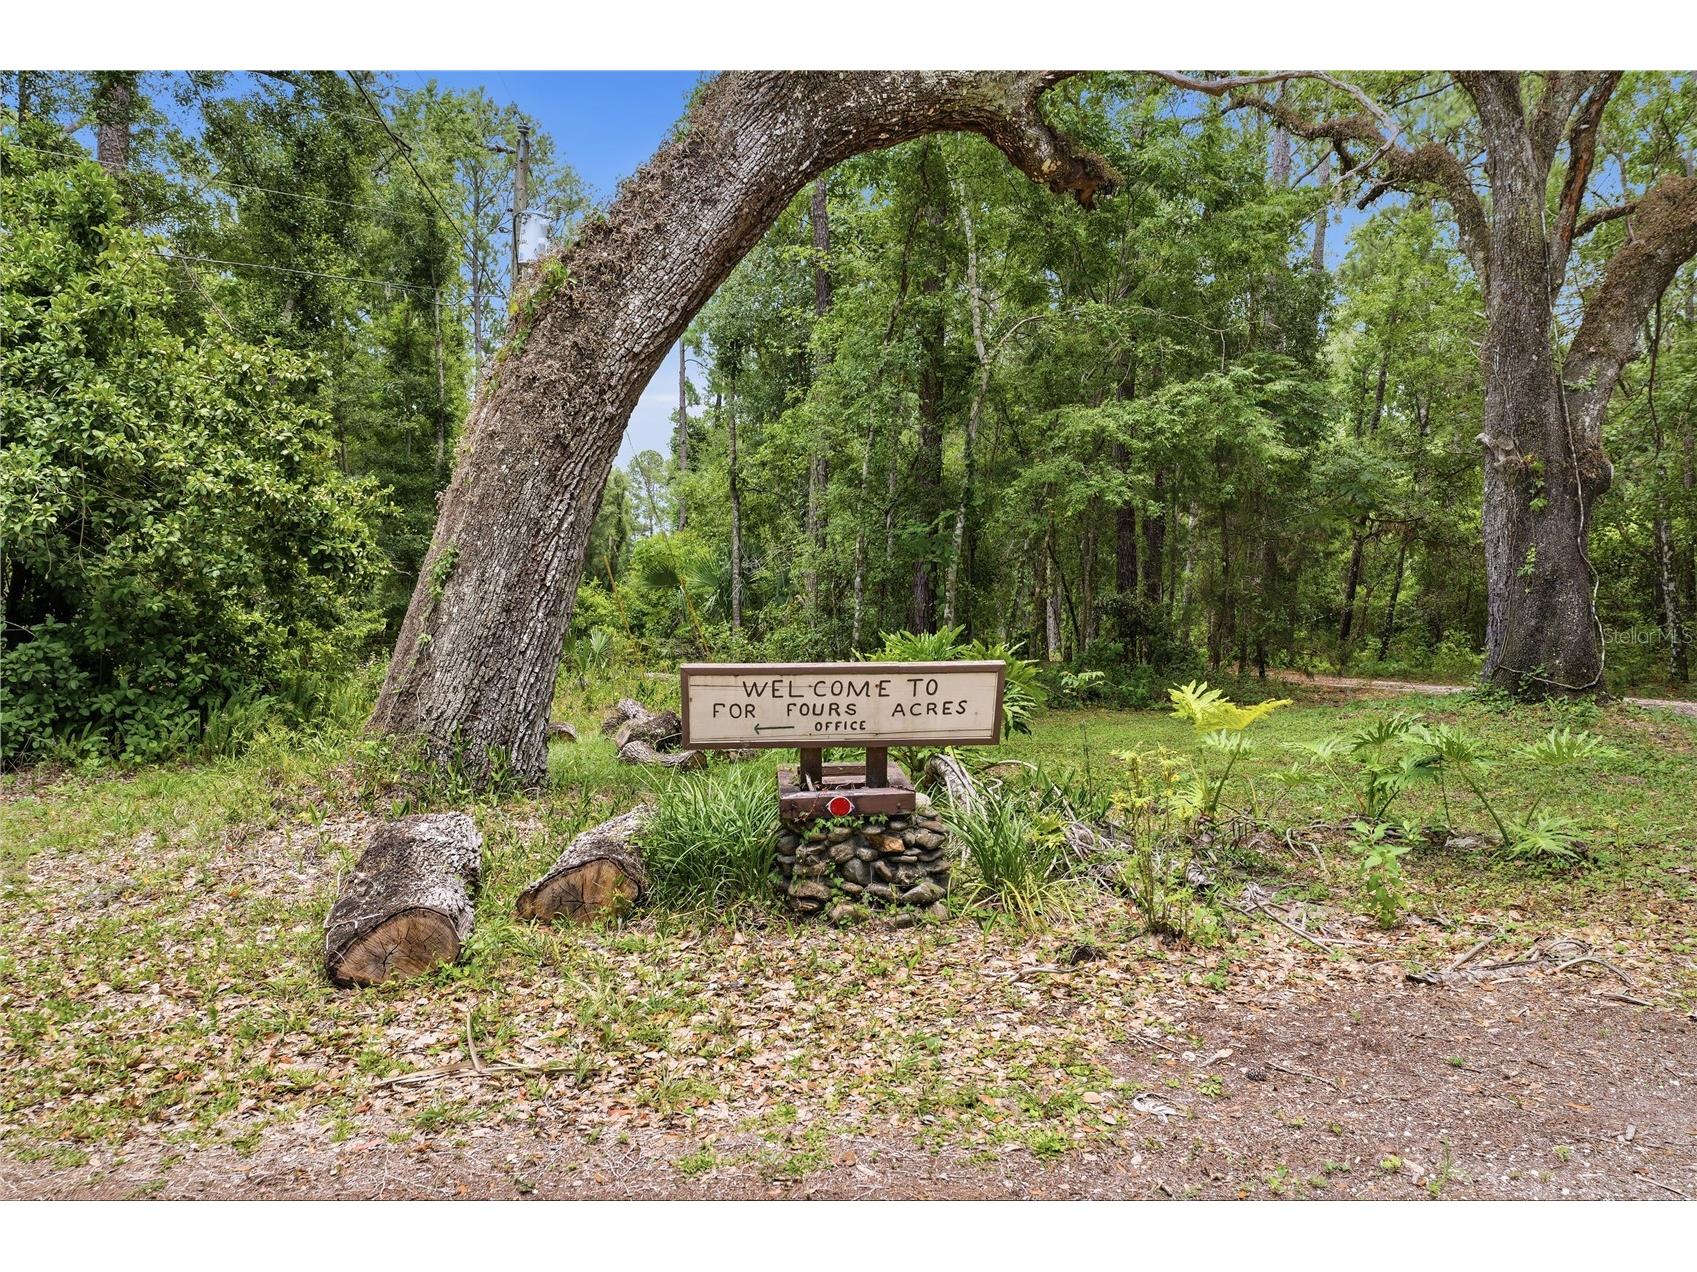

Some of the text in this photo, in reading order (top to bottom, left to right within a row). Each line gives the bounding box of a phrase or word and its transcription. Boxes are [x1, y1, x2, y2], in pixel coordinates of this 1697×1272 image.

[743, 678, 939, 698] WELCOME TO
[713, 699, 968, 718] FOR FOURS ACRES
[814, 720, 867, 732] OFFICE
